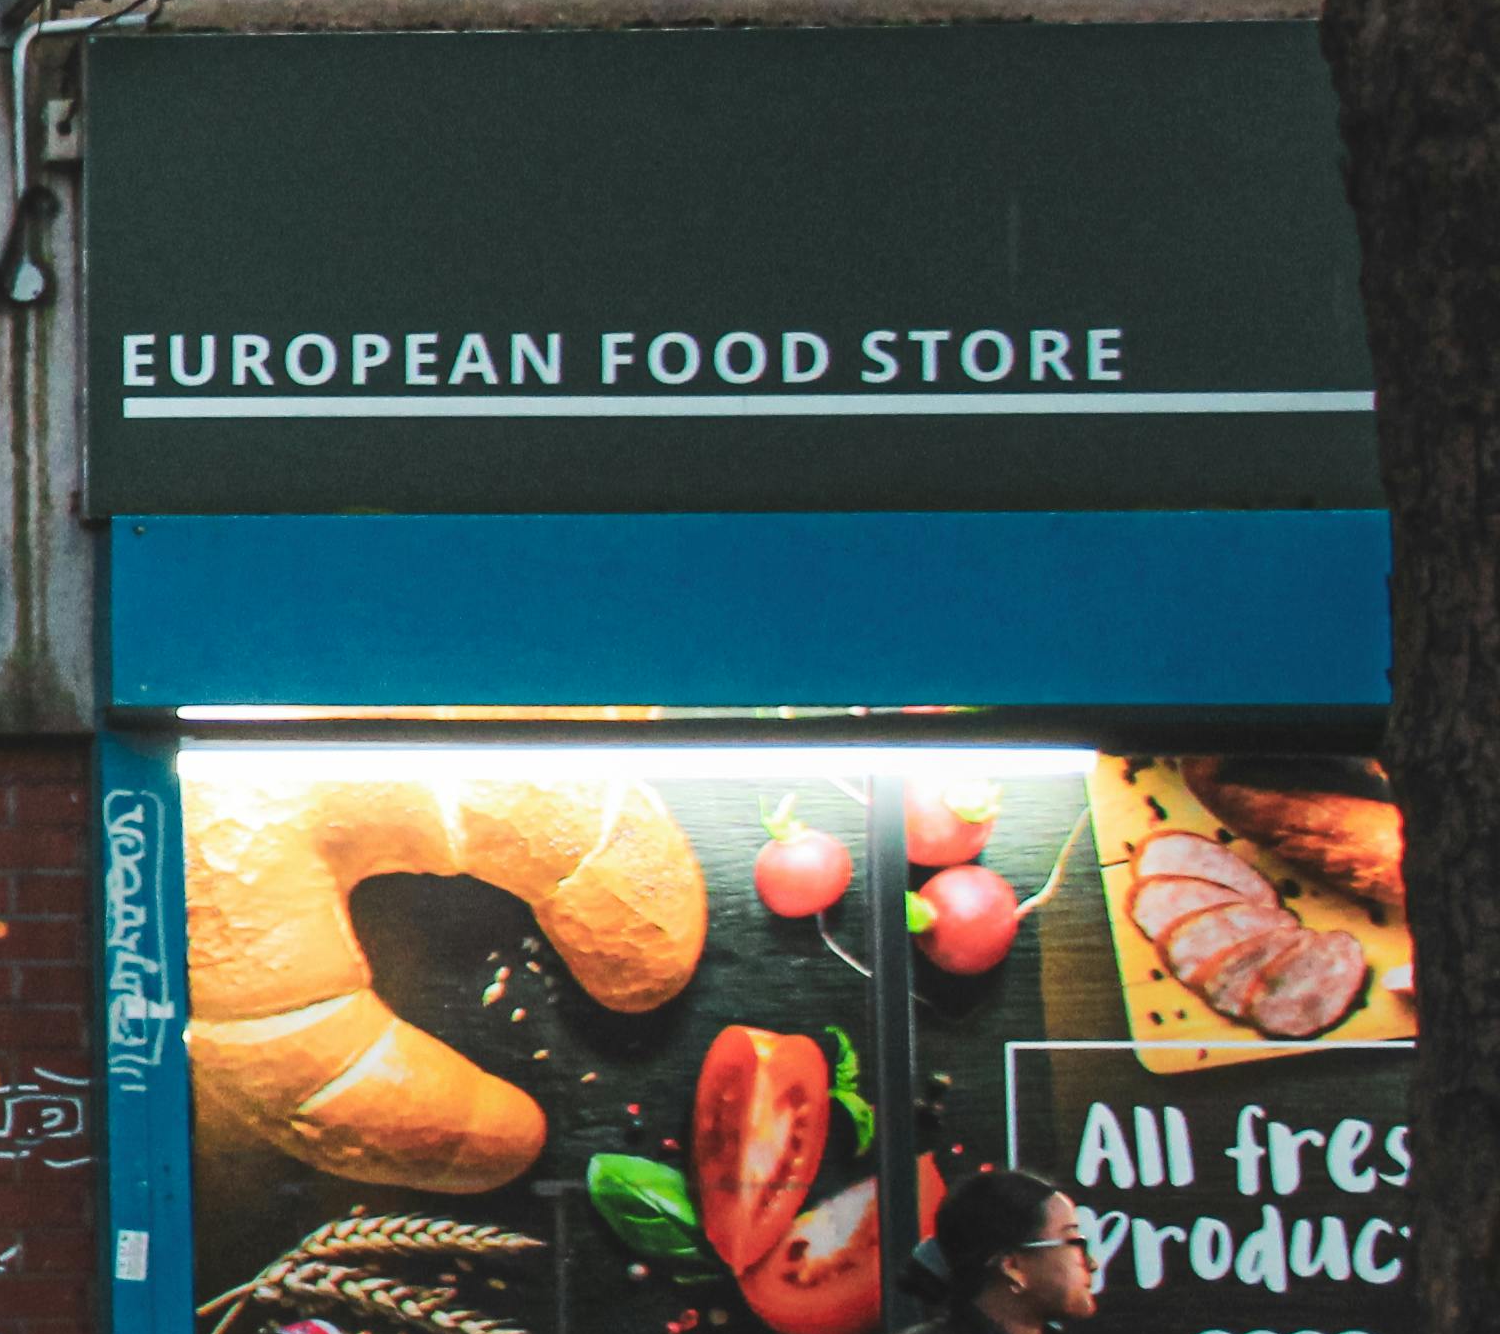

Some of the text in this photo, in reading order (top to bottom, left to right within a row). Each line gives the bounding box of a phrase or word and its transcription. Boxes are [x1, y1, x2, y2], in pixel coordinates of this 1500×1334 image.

[122, 328, 1124, 388] EUROPEAN FOOD STORE
[1075, 1101, 1195, 1190] All
